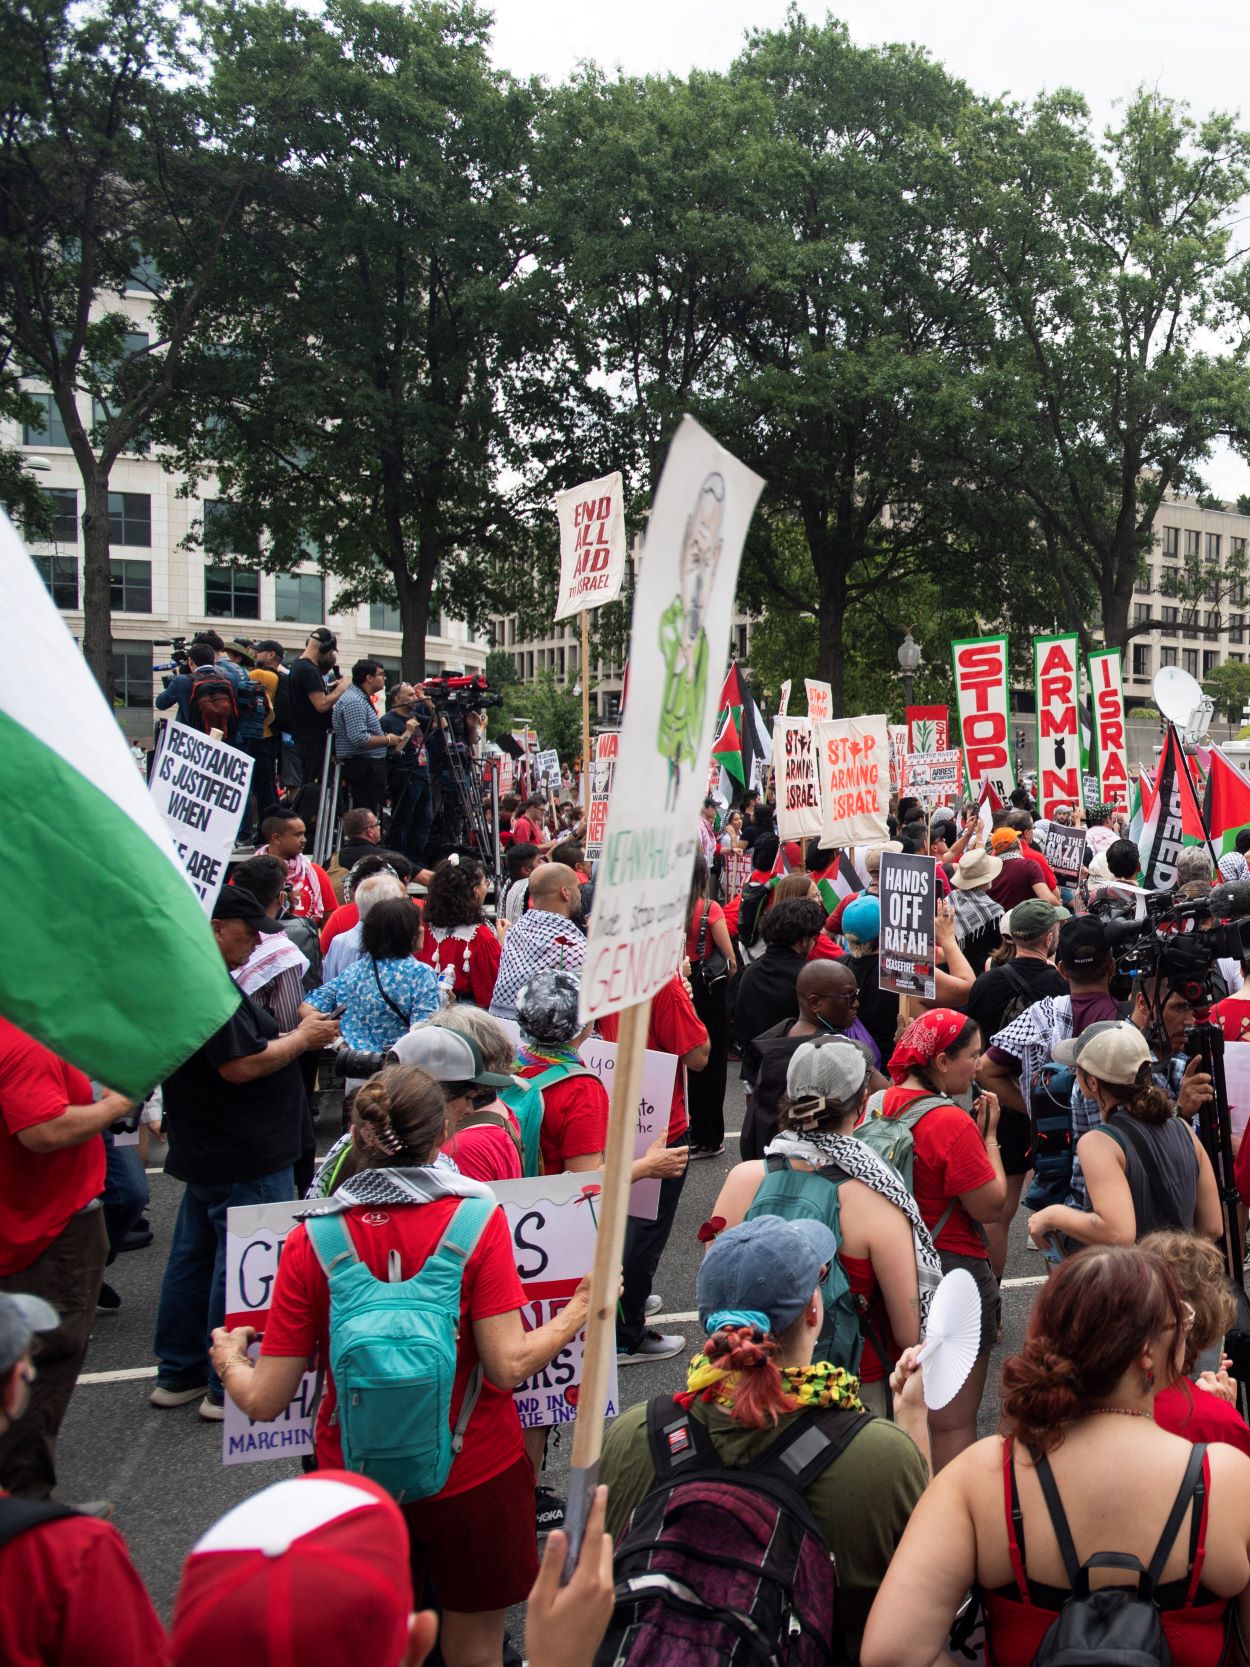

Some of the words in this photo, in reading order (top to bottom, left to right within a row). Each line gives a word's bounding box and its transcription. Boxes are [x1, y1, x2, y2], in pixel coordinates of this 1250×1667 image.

[574, 496, 611, 528] END
[574, 521, 609, 552] ALL
[573, 547, 610, 579] AID
[568, 586, 578, 597] TO
[577, 576, 610, 596] ISRAEL
[958, 645, 1007, 780] STOP
[166, 727, 249, 787] RESISTANCE
[827, 735, 876, 765] STOP
[159, 755, 173, 781] IS
[171, 764, 242, 814] JUSTIFIED
[830, 764, 879, 792] ARMING
[931, 767, 956, 775] ARREST
[166, 791, 212, 832] WHEN
[785, 784, 818, 811] ISRAEL
[833, 789, 881, 821] ISRAEL
[1046, 840, 1081, 864] GAZA
[1048, 832, 1066, 845] STOP
[1068, 837, 1083, 848] THE
[186, 849, 222, 886] ARE
[885, 868, 929, 895] HANDS
[888, 893, 923, 929] OFF
[884, 935, 928, 956] RAFAH
[546, 1393, 564, 1411] IN
